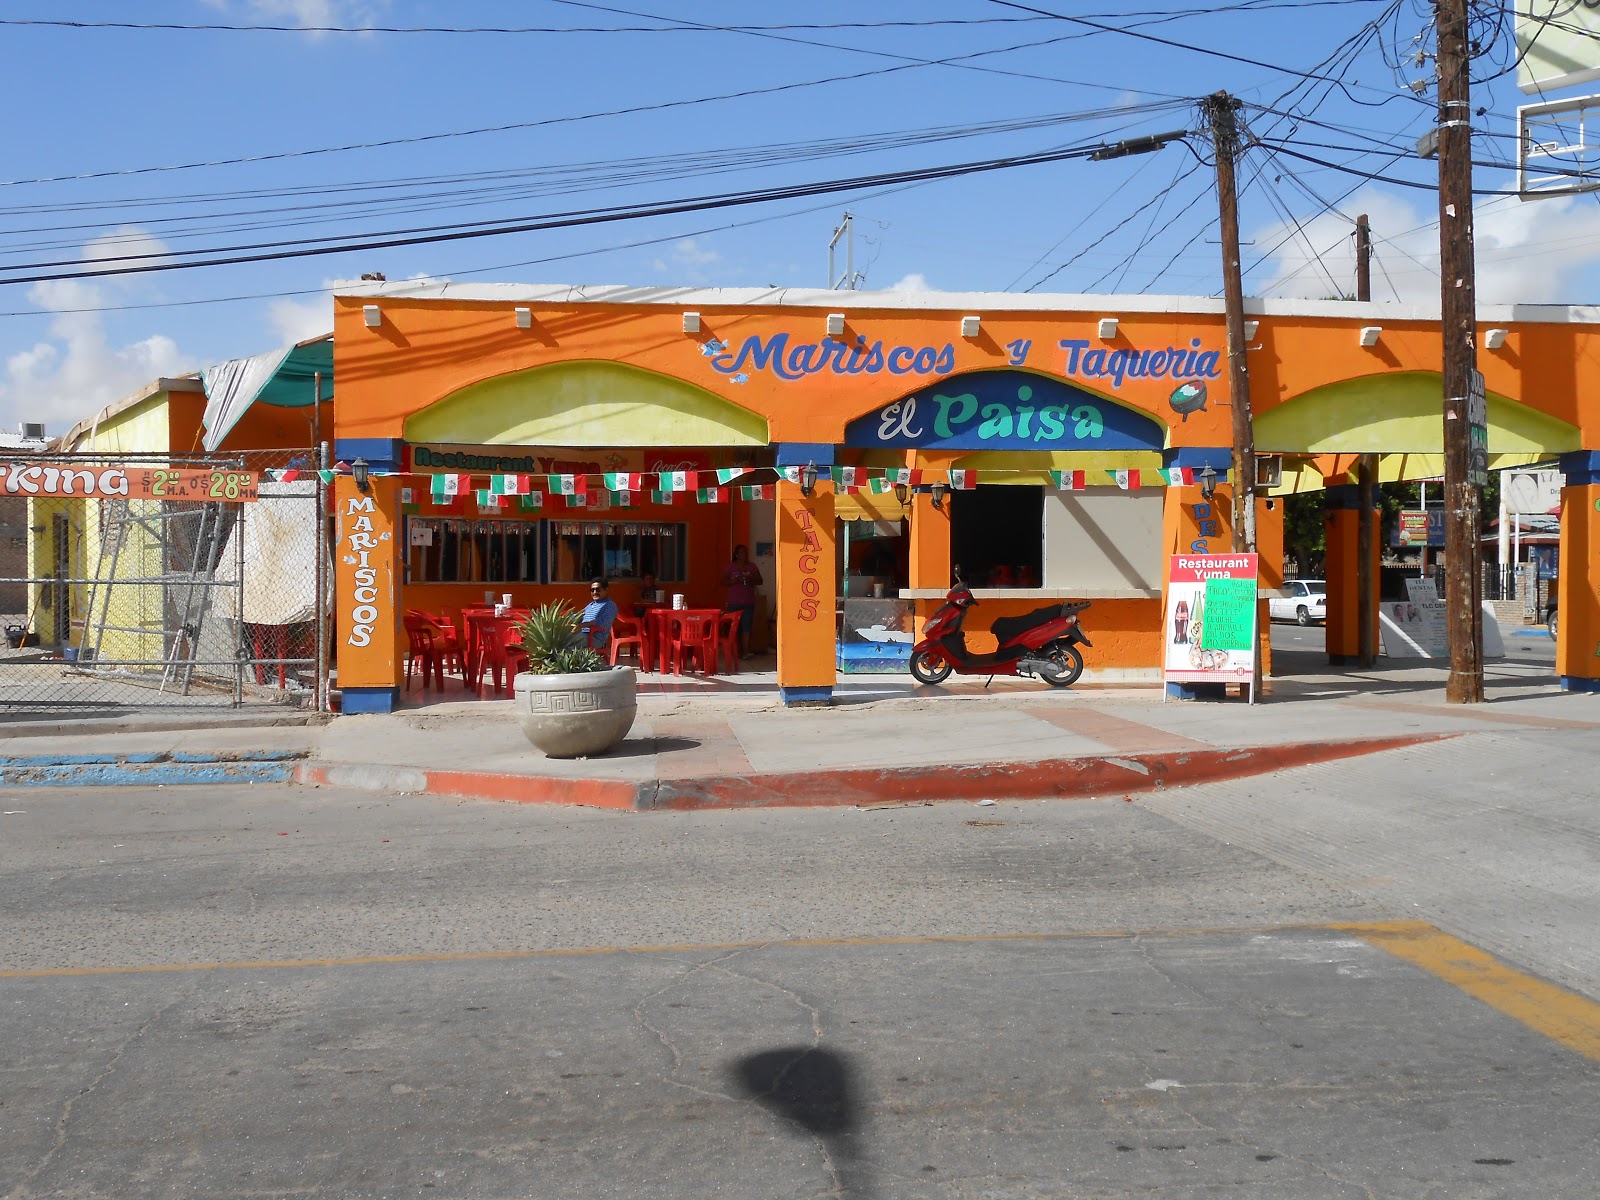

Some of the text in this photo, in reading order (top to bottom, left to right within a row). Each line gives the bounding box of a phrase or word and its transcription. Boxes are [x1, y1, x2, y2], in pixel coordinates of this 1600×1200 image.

[713, 335, 1221, 389] Mariscos y Taqueria
[877, 385, 1104, 442] El Paisa
[414, 447, 535, 473] Restaurant
[346, 496, 379, 648] MARISCOS
[794, 507, 822, 621] TACOS
[1178, 557, 1249, 569] Restaurant
[1194, 569, 1231, 580] Yuma
